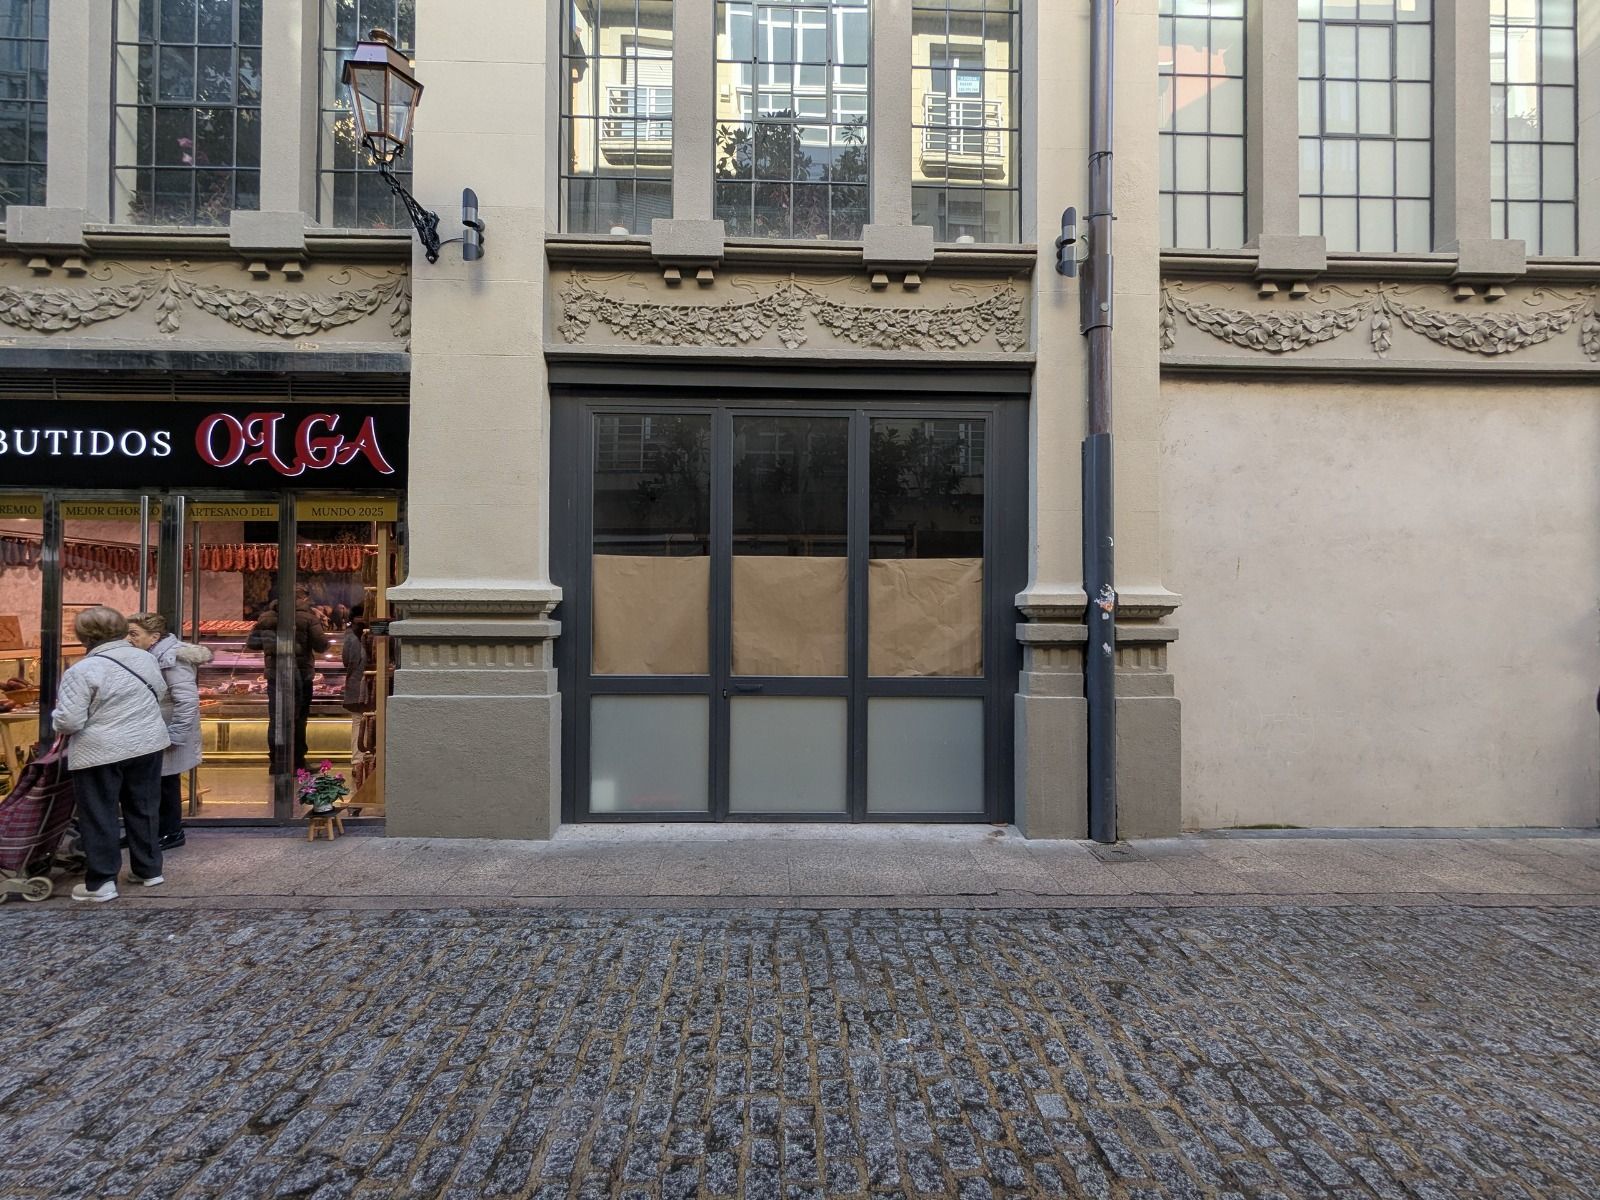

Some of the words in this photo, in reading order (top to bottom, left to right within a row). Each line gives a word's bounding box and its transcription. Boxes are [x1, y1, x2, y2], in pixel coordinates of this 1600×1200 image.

[195, 412, 396, 477] OLGA
[65, 506, 105, 516] MEJOR
[107, 506, 160, 516] CHORO
[188, 507, 249, 517] ARTESANO
[251, 507, 273, 517] DEL
[311, 507, 356, 517] MUNDO
[358, 507, 384, 517] 2025
